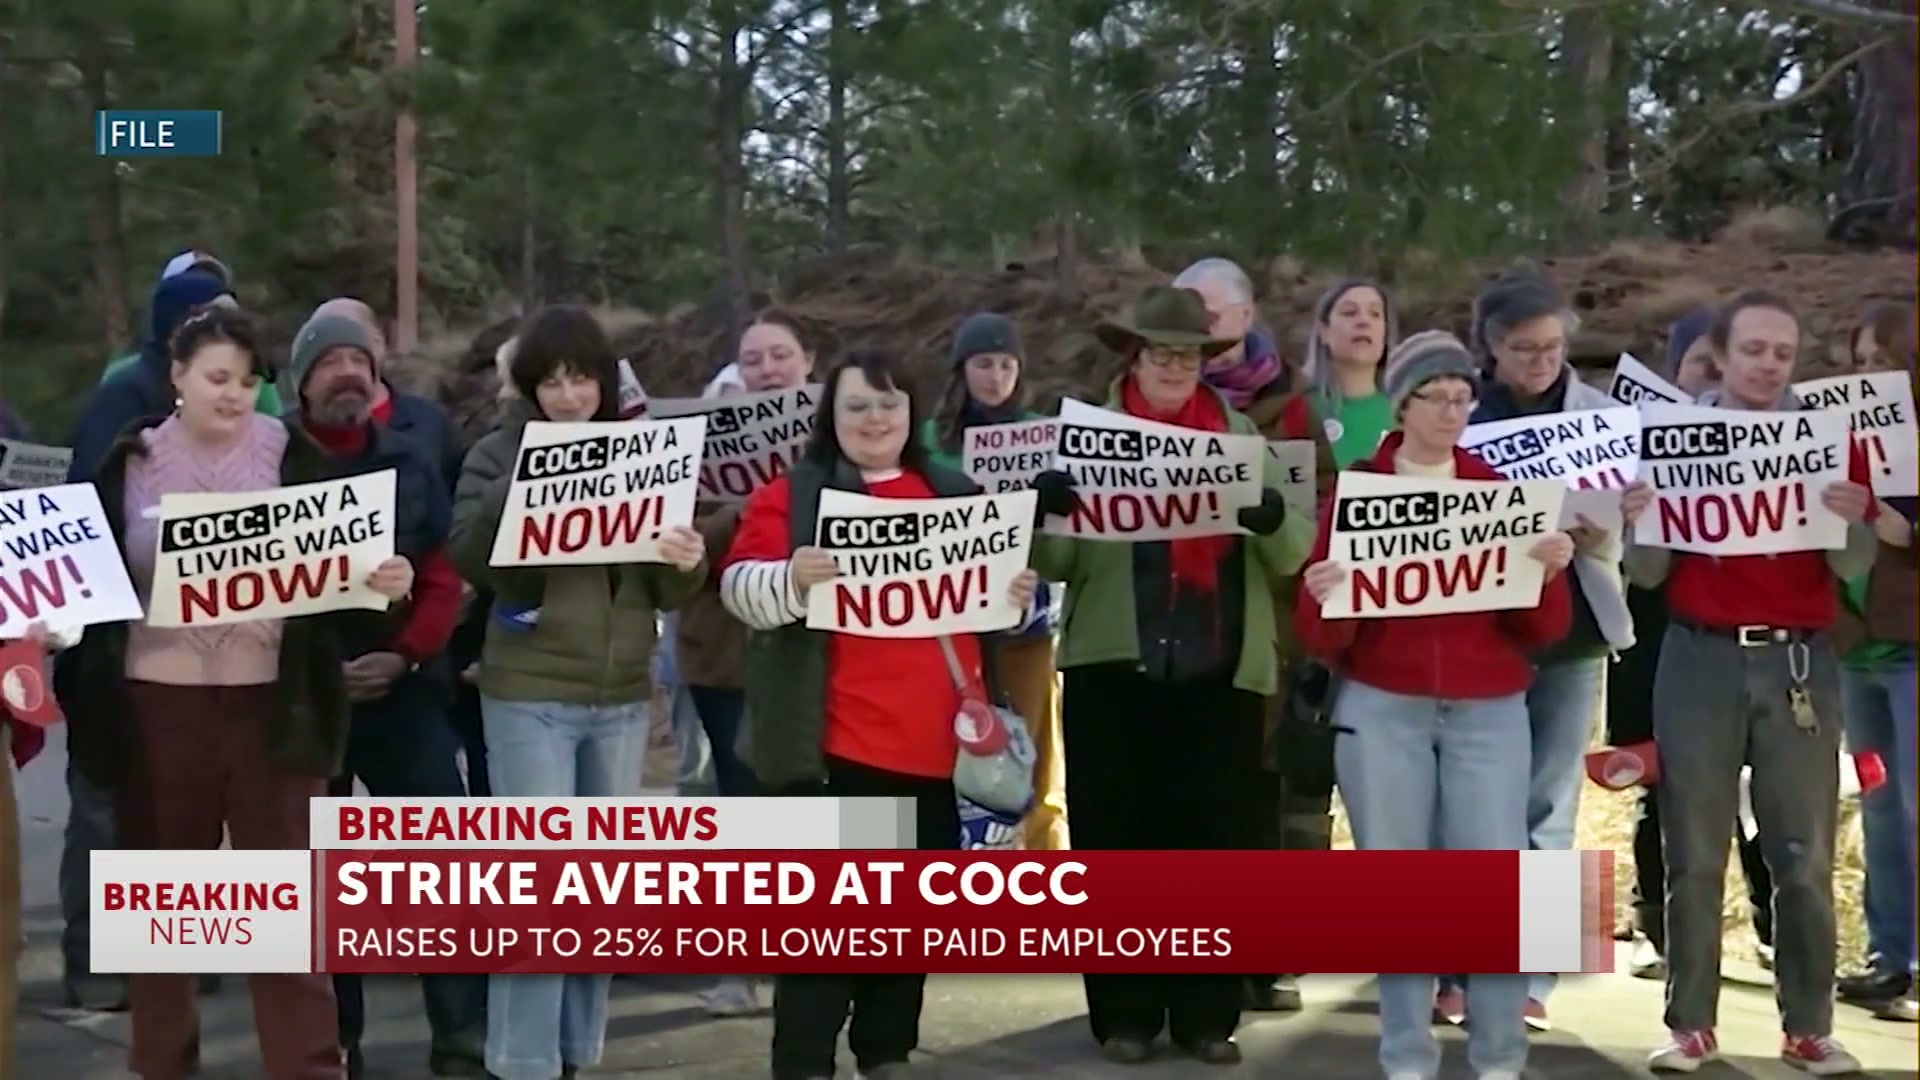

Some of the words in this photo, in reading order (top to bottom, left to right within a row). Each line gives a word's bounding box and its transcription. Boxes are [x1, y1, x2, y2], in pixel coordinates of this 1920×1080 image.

[738, 396, 785, 425] PAY
[796, 390, 812, 408] A
[1859, 379, 1877, 399] A
[527, 441, 605, 477] COCC:
[611, 430, 659, 462] PAY
[663, 426, 677, 449] A
[975, 431, 1004, 449] NO
[1010, 424, 1056, 447] MOR
[1065, 427, 1139, 457] COCC:
[1146, 438, 1196, 457] PAY
[1206, 437, 1224, 455] A
[1540, 419, 1585, 447] PAY
[1593, 414, 1610, 432] A
[1568, 435, 1639, 469] WAGE
[1648, 424, 1724, 456] COCC:
[1731, 421, 1784, 449] PAY
[1795, 417, 1813, 440] A
[525, 474, 615, 509] LIVING
[625, 454, 693, 492] WAGE
[973, 450, 1053, 473] POVERT
[1165, 463, 1251, 487] WAGE
[1653, 462, 1744, 490] LIVING
[1752, 444, 1839, 481] WAGE
[38, 493, 60, 515] A
[171, 510, 267, 549] COCC:
[273, 493, 329, 527] PAY
[339, 485, 359, 512] A
[829, 517, 916, 546] COCC:
[922, 505, 973, 537] PAY
[983, 499, 999, 523] A
[1072, 490, 1221, 534] NOW!
[1347, 495, 1435, 528] COCC:
[1443, 489, 1497, 517] PAY
[1507, 485, 1526, 506] A
[1658, 483, 1807, 543] NOW!
[4, 517, 101, 560] WAGE
[177, 539, 286, 578] LIVING
[295, 510, 384, 555] WAGE
[518, 495, 664, 560] NOW!
[1350, 529, 1451, 561] LIVING
[1461, 511, 1546, 546] WAGE
[833, 549, 931, 577] LIVING
[941, 525, 1020, 565] WAGE
[179, 555, 350, 624] NOW!
[836, 565, 988, 628] NOW!
[1351, 546, 1507, 613] NOW!
